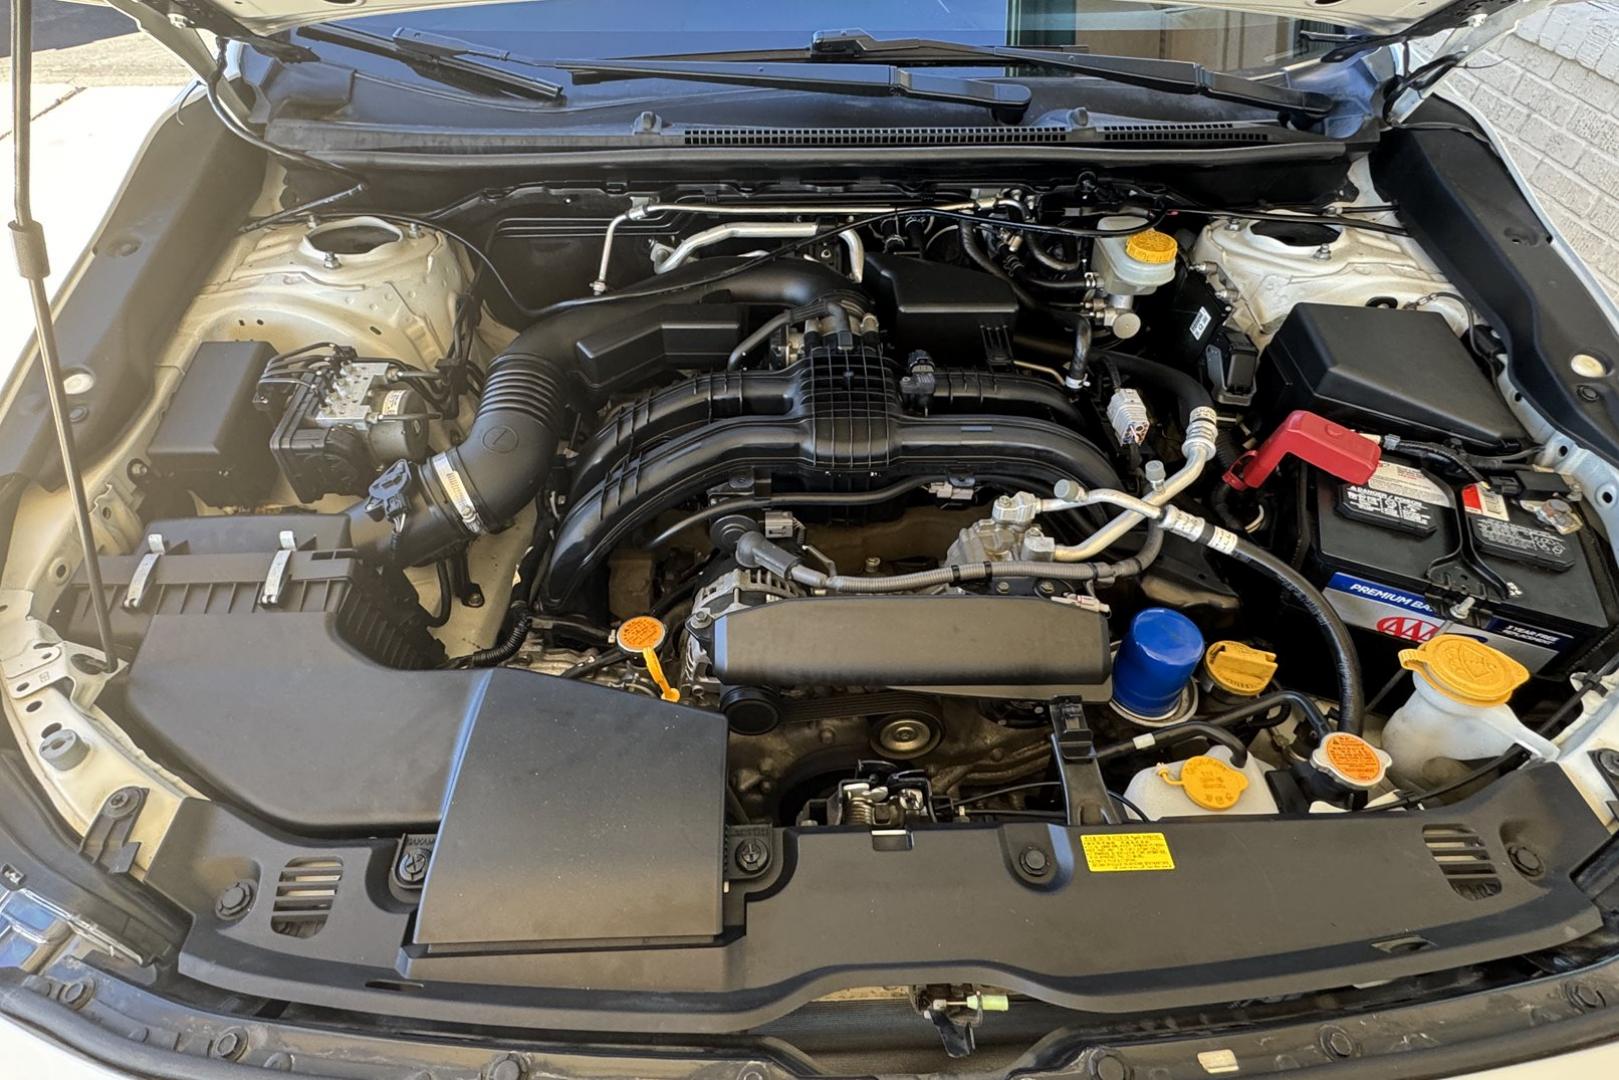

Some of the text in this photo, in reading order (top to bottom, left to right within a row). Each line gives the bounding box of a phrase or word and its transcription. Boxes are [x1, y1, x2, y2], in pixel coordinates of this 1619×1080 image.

[1350, 583, 1411, 606] PREMIUM
[1513, 626, 1537, 636] YEAR
[1535, 632, 1560, 642] FREE
